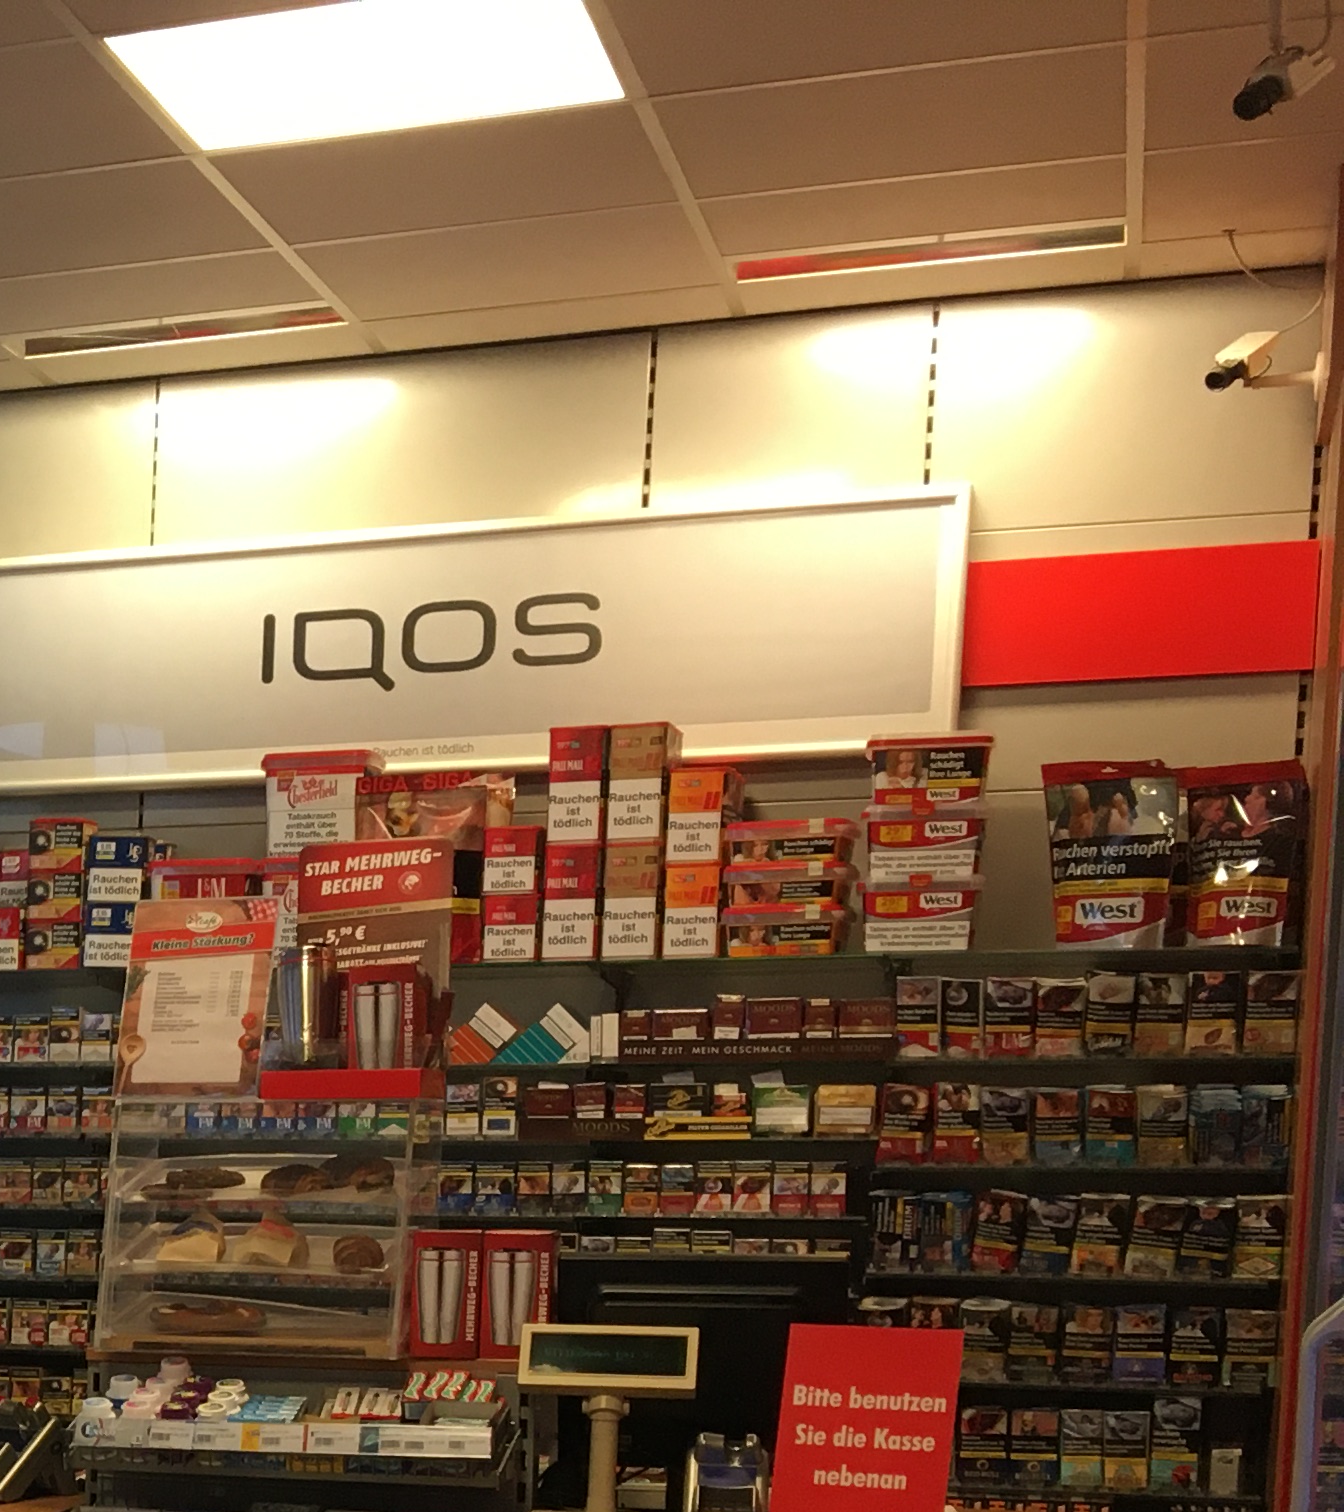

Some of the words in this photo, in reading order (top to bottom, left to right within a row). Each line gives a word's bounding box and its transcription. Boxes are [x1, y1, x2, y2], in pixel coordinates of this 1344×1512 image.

[262, 593, 602, 691] IQOS
[373, 748, 418, 757] Rauchen
[421, 745, 434, 755] ist
[438, 743, 474, 754] tödlich
[358, 775, 408, 794] GIGA
[287, 780, 338, 808] Chesterfield
[550, 794, 599, 804] Rauchen
[610, 792, 660, 802] Rauchen
[929, 790, 956, 798] West
[566, 807, 580, 815] ist
[627, 804, 641, 813] ist
[287, 812, 336, 820] Tabakrauch
[614, 816, 653, 826] tödlich
[285, 821, 315, 830] enthält
[317, 821, 336, 829] über
[553, 819, 592, 828] tödlich
[669, 821, 718, 830] Rauchen
[928, 824, 963, 834] West
[296, 830, 323, 839] Stoffe,
[326, 830, 339, 838] die
[686, 832, 700, 841] ist
[673, 844, 711, 853] tödlich
[1101, 840, 1171, 858] verstopft
[305, 861, 340, 877] STAR
[345, 848, 442, 872] MEHRWEG-
[487, 859, 532, 868] Rauchen
[502, 869, 515, 878] ist
[1066, 862, 1126, 876] Arterien
[321, 874, 384, 896] BECHER
[491, 879, 525, 889] tödlich
[89, 887, 102, 895] ist
[105, 885, 139, 895] tödlich
[924, 896, 958, 905] West
[1081, 901, 1137, 920] West
[1225, 898, 1272, 914] West
[544, 912, 594, 921] Rauchen
[604, 910, 655, 920] Rauchen
[666, 916, 715, 925] Rauchen
[487, 927, 532, 936] Rauchen
[561, 924, 575, 932] ist
[622, 923, 635, 931] ist
[683, 927, 697, 935] ist
[326, 926, 352, 946] 5,90
[355, 926, 366, 940] €
[548, 935, 587, 945] tödlich
[608, 934, 648, 944] tödlich
[152, 940, 190, 951] Kleine
[192, 933, 254, 948] Stärkung?
[670, 938, 708, 947] tödlich
[491, 947, 526, 956] tödlich
[85, 953, 98, 961] ist
[624, 1047, 656, 1055] MEINE
[692, 1046, 719, 1054] MEIN
[724, 1045, 792, 1054] GESCHMACK
[572, 1120, 630, 1134] MOODS
[465, 1251, 478, 1341] MEHRWEG-BECHER
[793, 1384, 843, 1408] Bitte
[849, 1386, 947, 1414] benutzen
[795, 1424, 825, 1447] Sie
[833, 1425, 867, 1449] die
[873, 1428, 936, 1453] Kasse
[813, 1468, 907, 1491] nebenan
